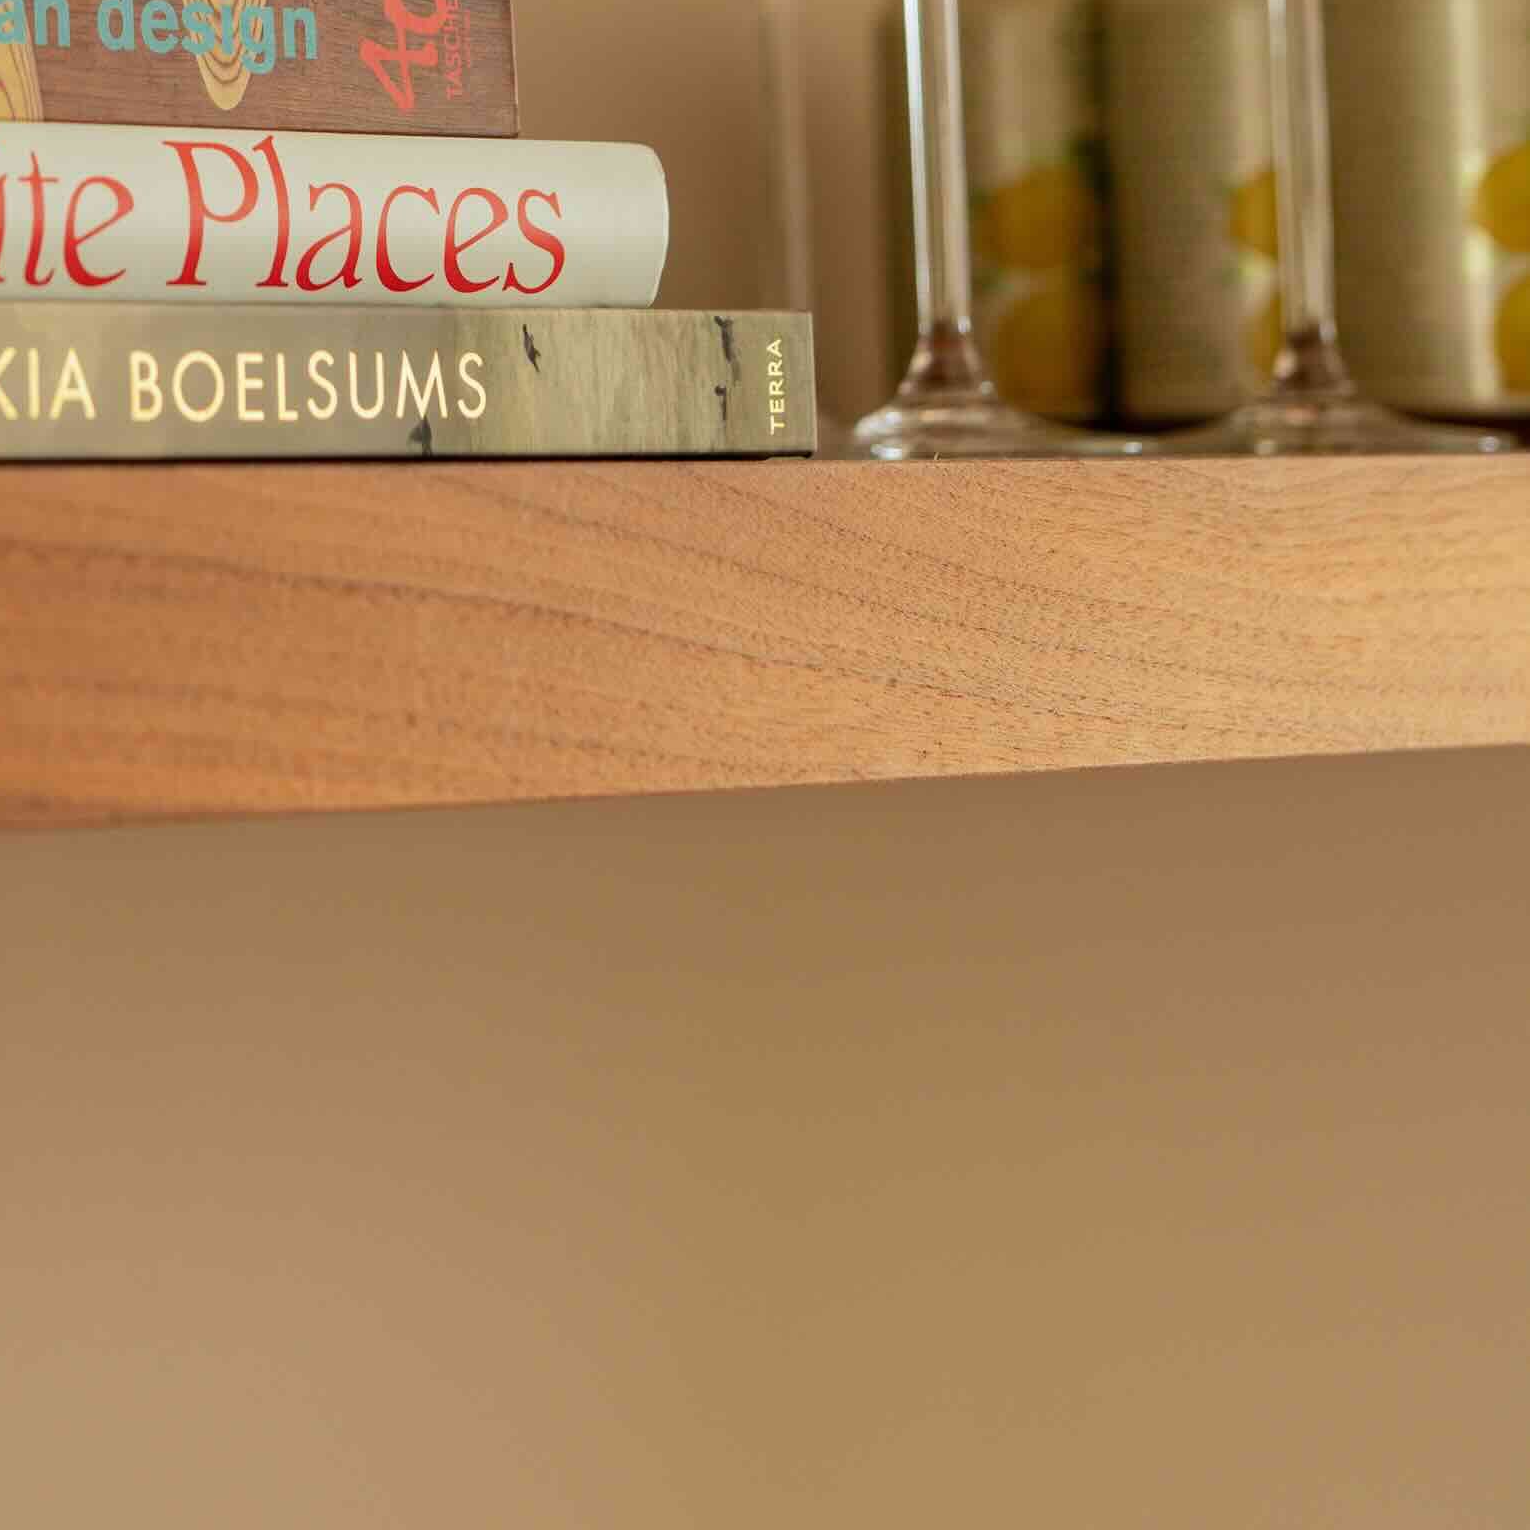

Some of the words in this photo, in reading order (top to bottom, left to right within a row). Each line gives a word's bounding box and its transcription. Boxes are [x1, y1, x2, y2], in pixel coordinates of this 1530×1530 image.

[162, 136, 566, 294] Places
[129, 350, 487, 422] BOELSUMS
[767, 338, 786, 435] TERRA
